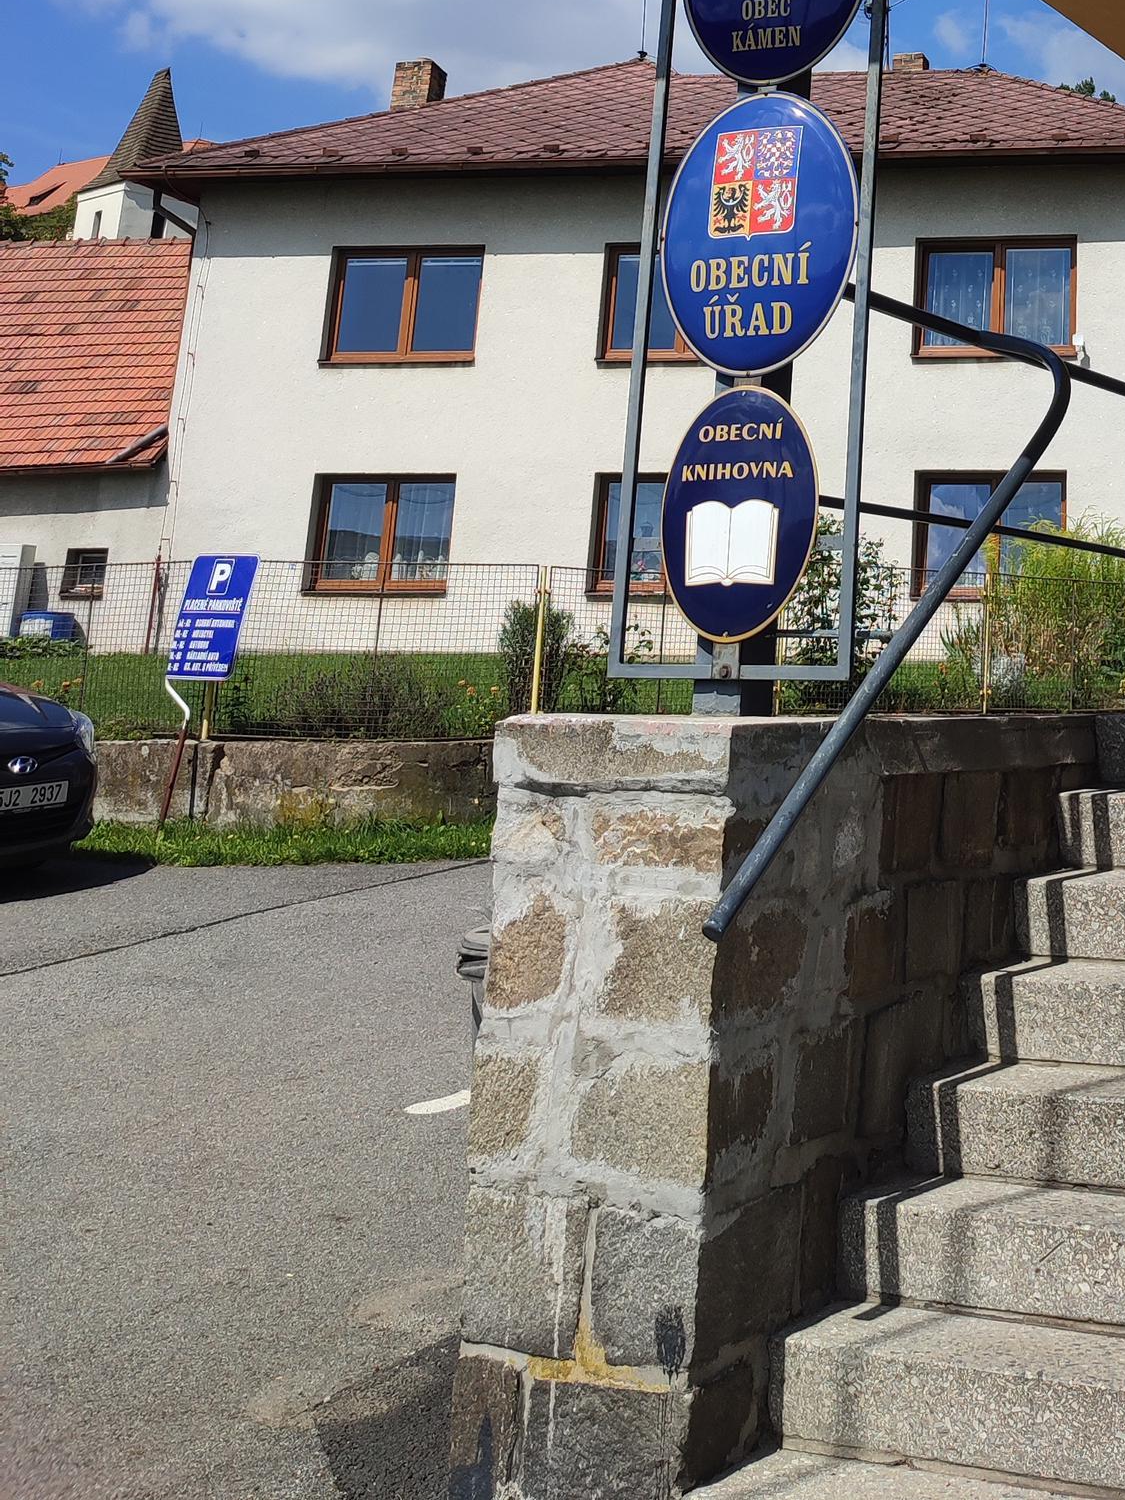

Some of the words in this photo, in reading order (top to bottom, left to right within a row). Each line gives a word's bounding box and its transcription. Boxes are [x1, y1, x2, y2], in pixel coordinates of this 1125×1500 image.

[731, 22, 801, 52] KÁMEN
[690, 241, 812, 293] OBECNÍ
[703, 292, 793, 339] ÚŘAD
[698, 416, 784, 443] OBECNÍ
[681, 461, 794, 482] KNIHOVNA
[209, 563, 232, 591] P
[30, 783, 63, 804] 2937
